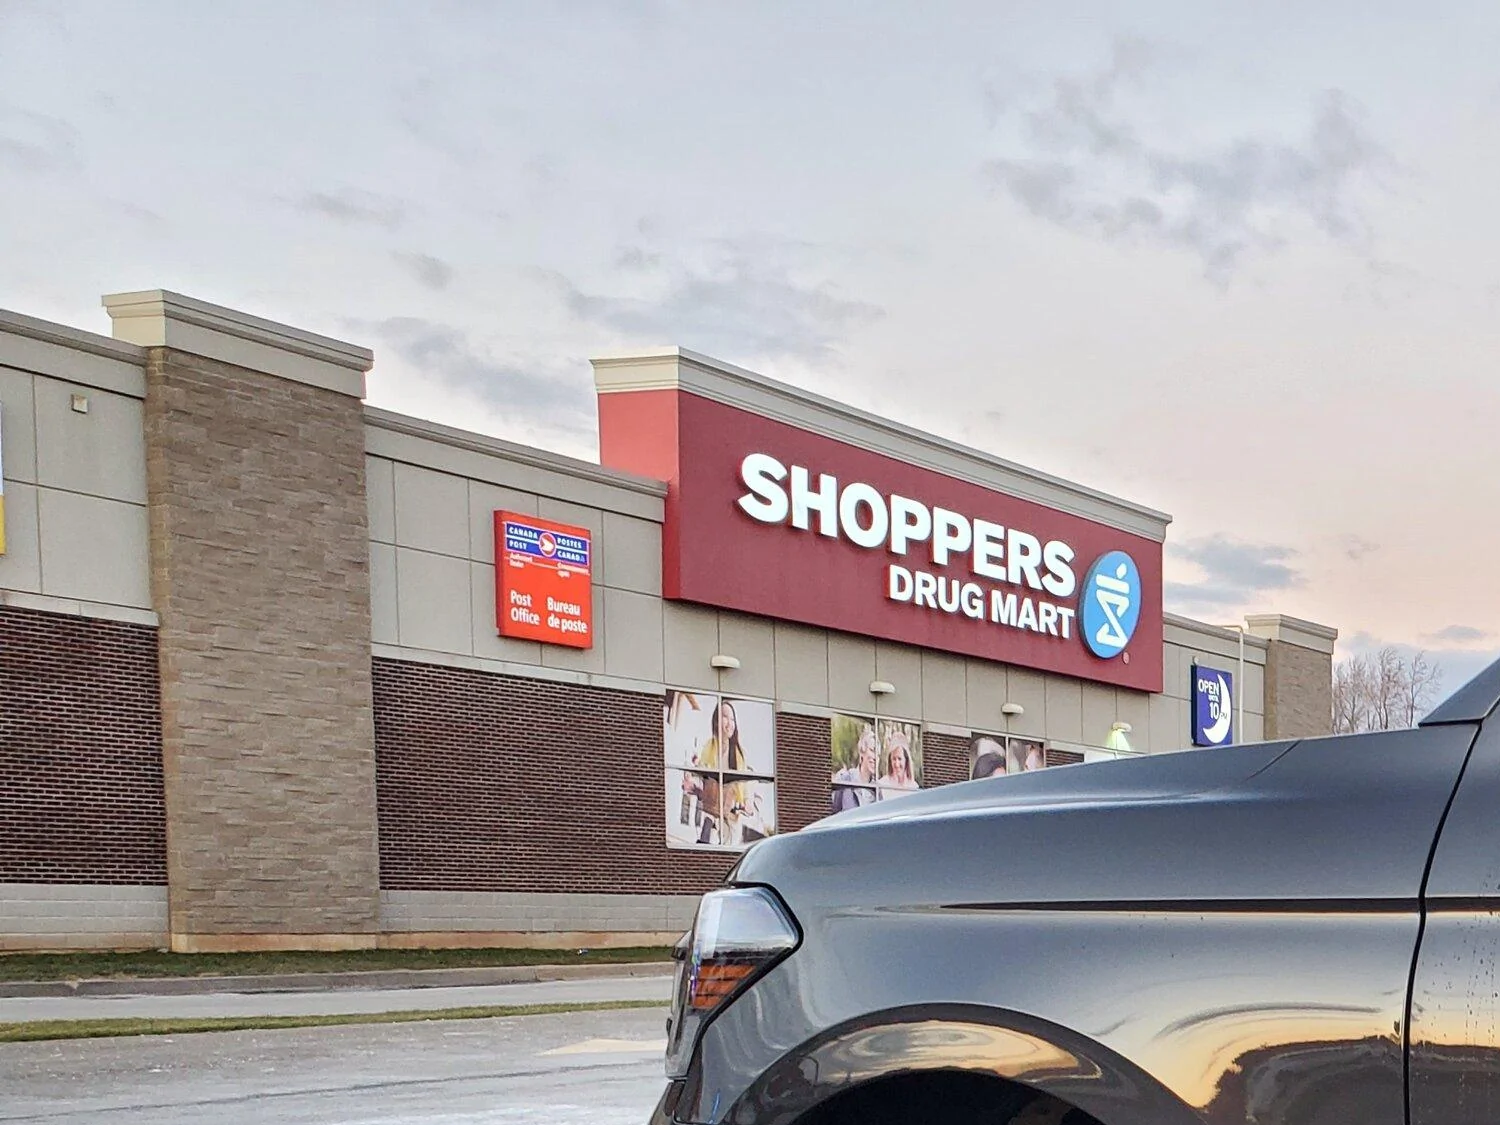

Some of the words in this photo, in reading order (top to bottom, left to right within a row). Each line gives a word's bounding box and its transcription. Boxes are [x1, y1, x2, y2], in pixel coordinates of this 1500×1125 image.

[508, 526, 538, 539] CANADA
[737, 453, 1076, 598] SHOPPERS
[509, 539, 527, 550] POST
[557, 537, 582, 549] POSTES
[557, 551, 586, 563] CANADA
[510, 589, 532, 607] Post
[547, 596, 581, 616] Bureau
[889, 564, 983, 619] DRUG
[991, 589, 1075, 639] MART
[511, 607, 540, 625] Office
[547, 613, 560, 628] de
[561, 618, 588, 633] poste
[1198, 679, 1220, 696] OPEN
[1210, 702, 1220, 720] 10
